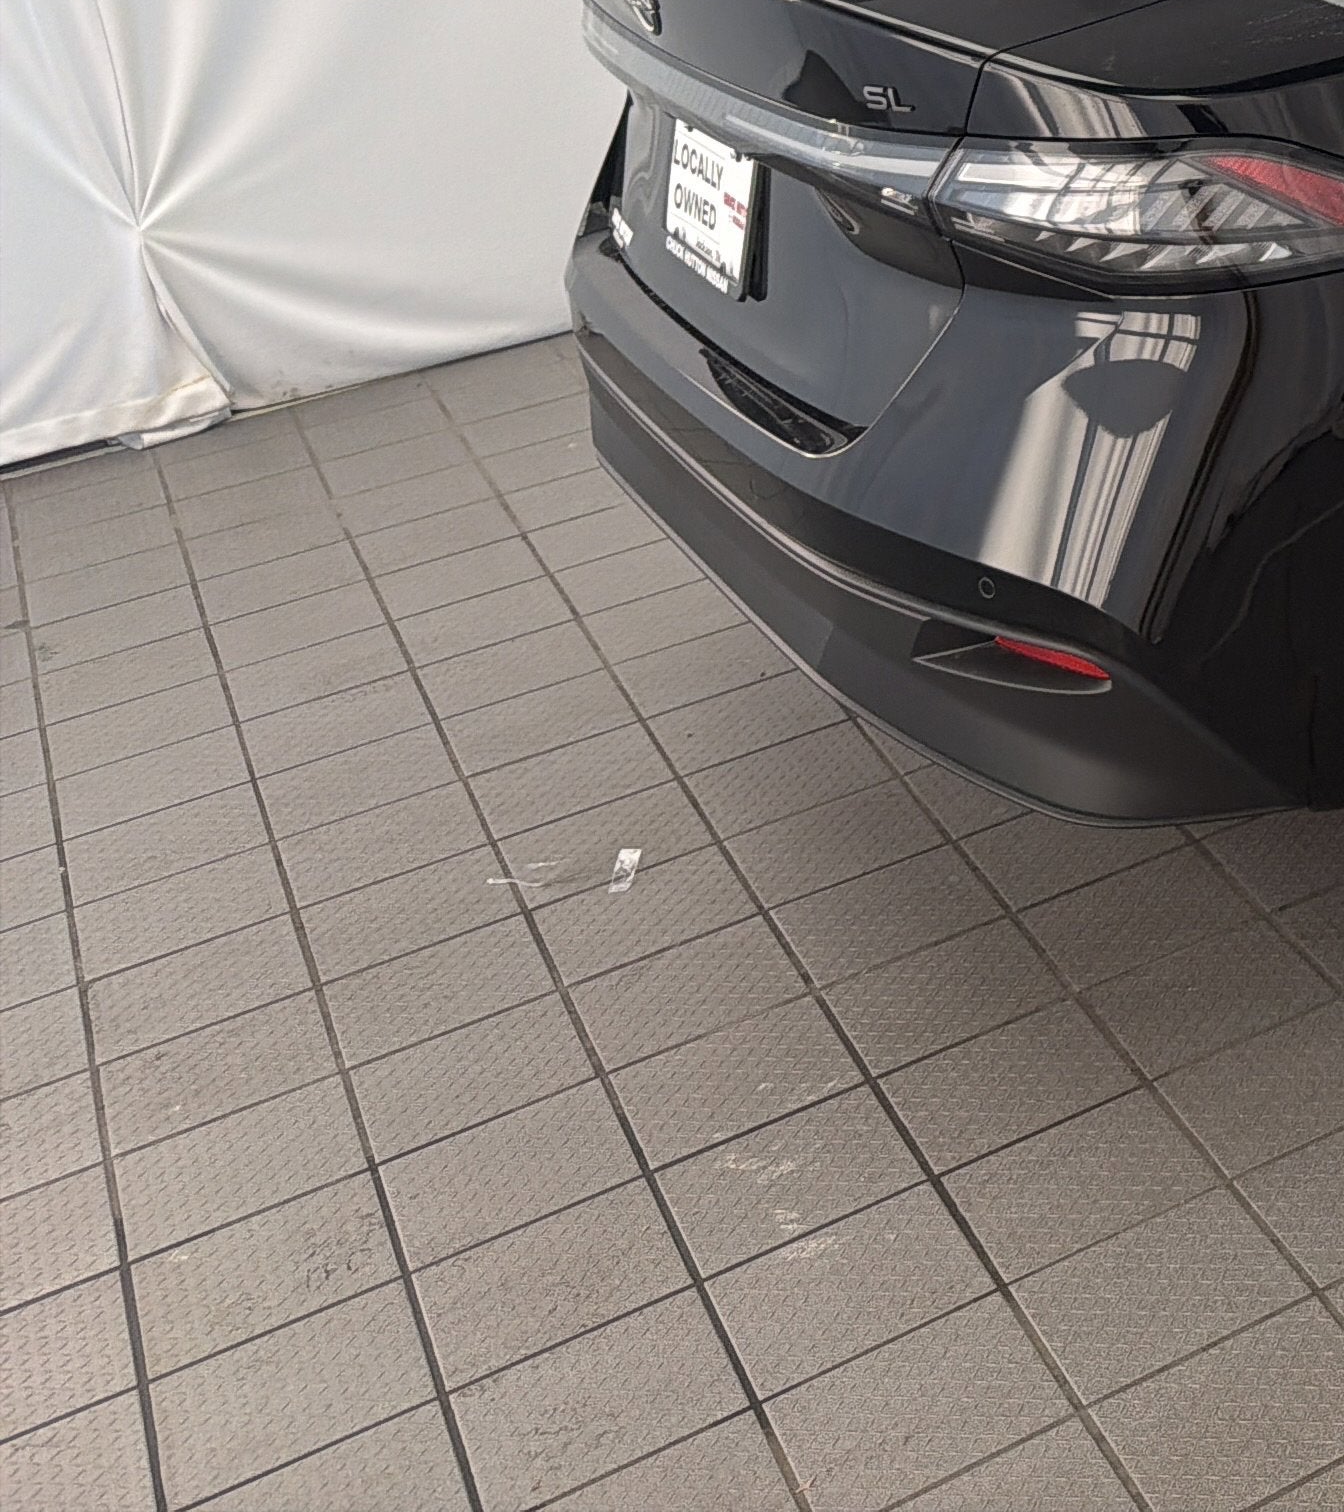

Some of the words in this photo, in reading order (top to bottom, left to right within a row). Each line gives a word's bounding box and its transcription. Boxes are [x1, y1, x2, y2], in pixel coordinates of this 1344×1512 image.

[863, 85, 912, 112] SL
[673, 139, 724, 190] LOCALLY
[674, 183, 717, 230] OWNED
